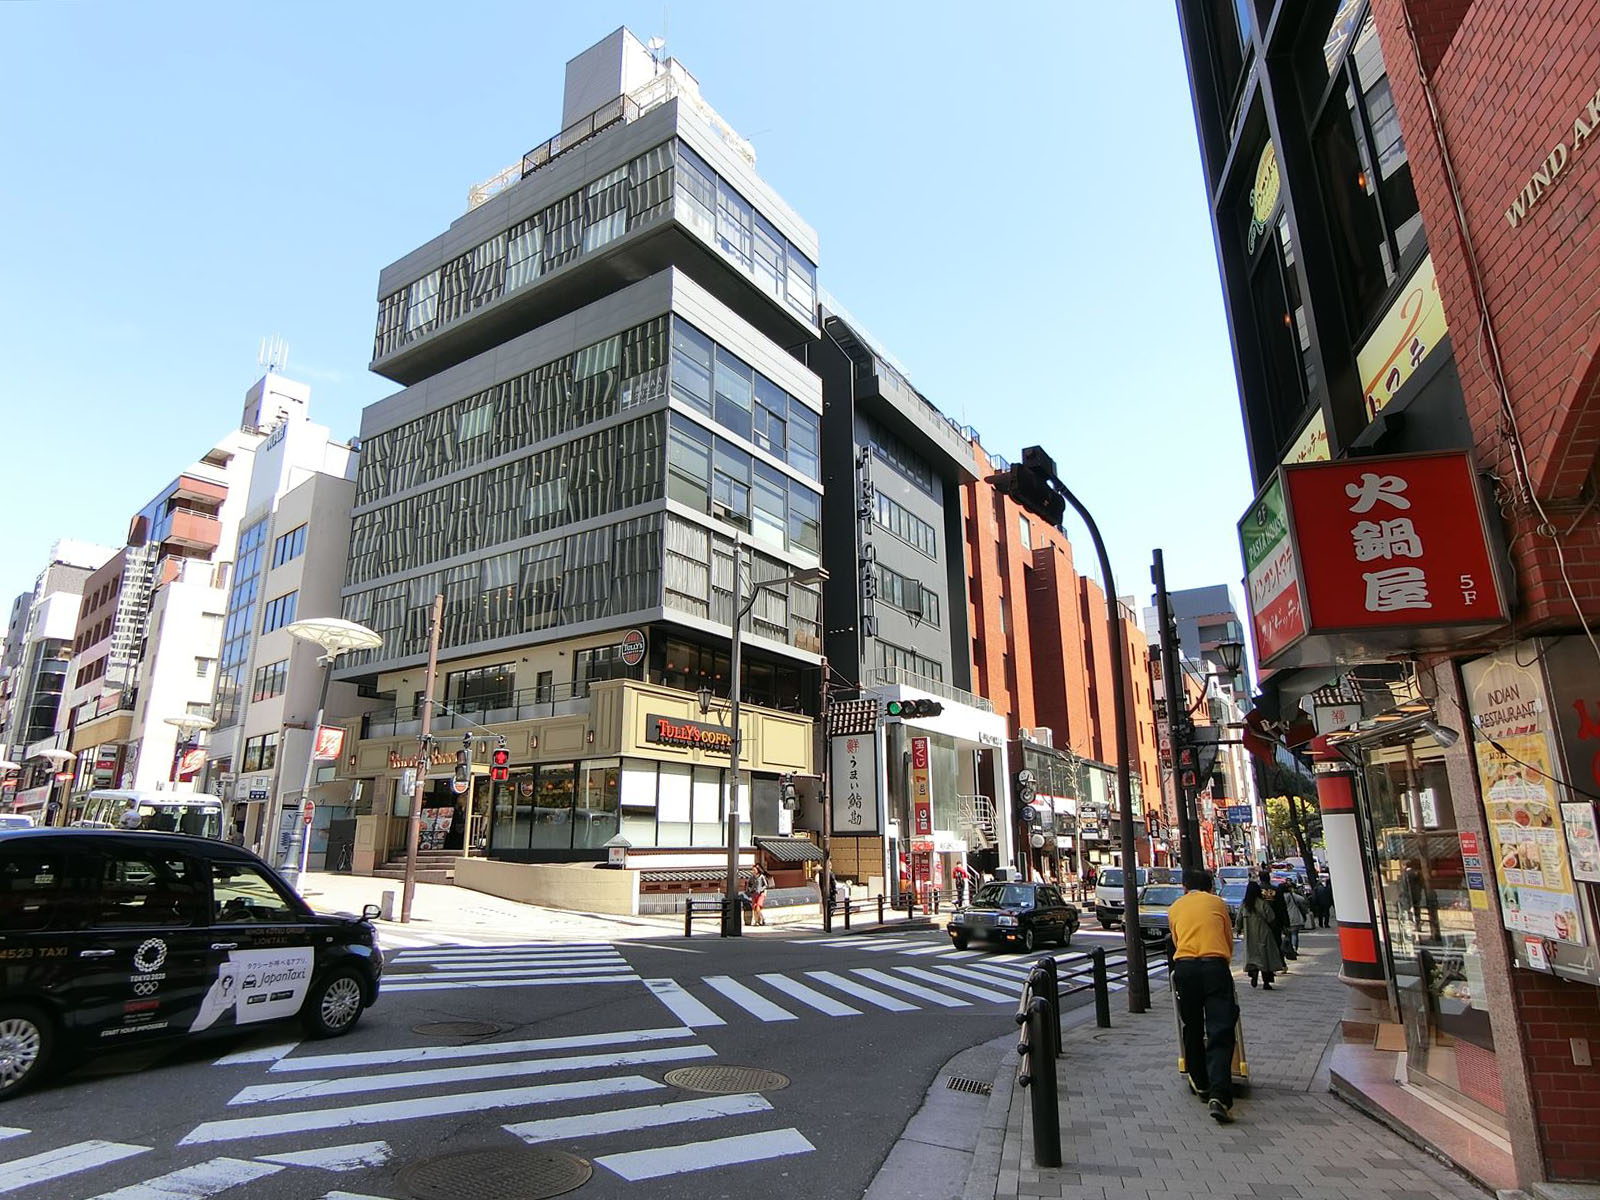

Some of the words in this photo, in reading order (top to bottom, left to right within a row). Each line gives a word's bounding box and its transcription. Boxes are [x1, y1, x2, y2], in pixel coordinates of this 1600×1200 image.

[1505, 143, 1567, 228] WIND
[860, 446, 874, 536] FIRST
[1248, 531, 1268, 564] PASTA
[1345, 473, 1433, 612] 火鍋屋
[861, 542, 878, 638] CABIN
[1487, 684, 1520, 707] INDIAN
[1479, 700, 1536, 729] RESTAURANT
[657, 719, 700, 742] TULLY'S
[40, 947, 69, 958] TAXI
[130, 975, 151, 983] TOKYO
[257, 968, 306, 989] JapanTaxi
